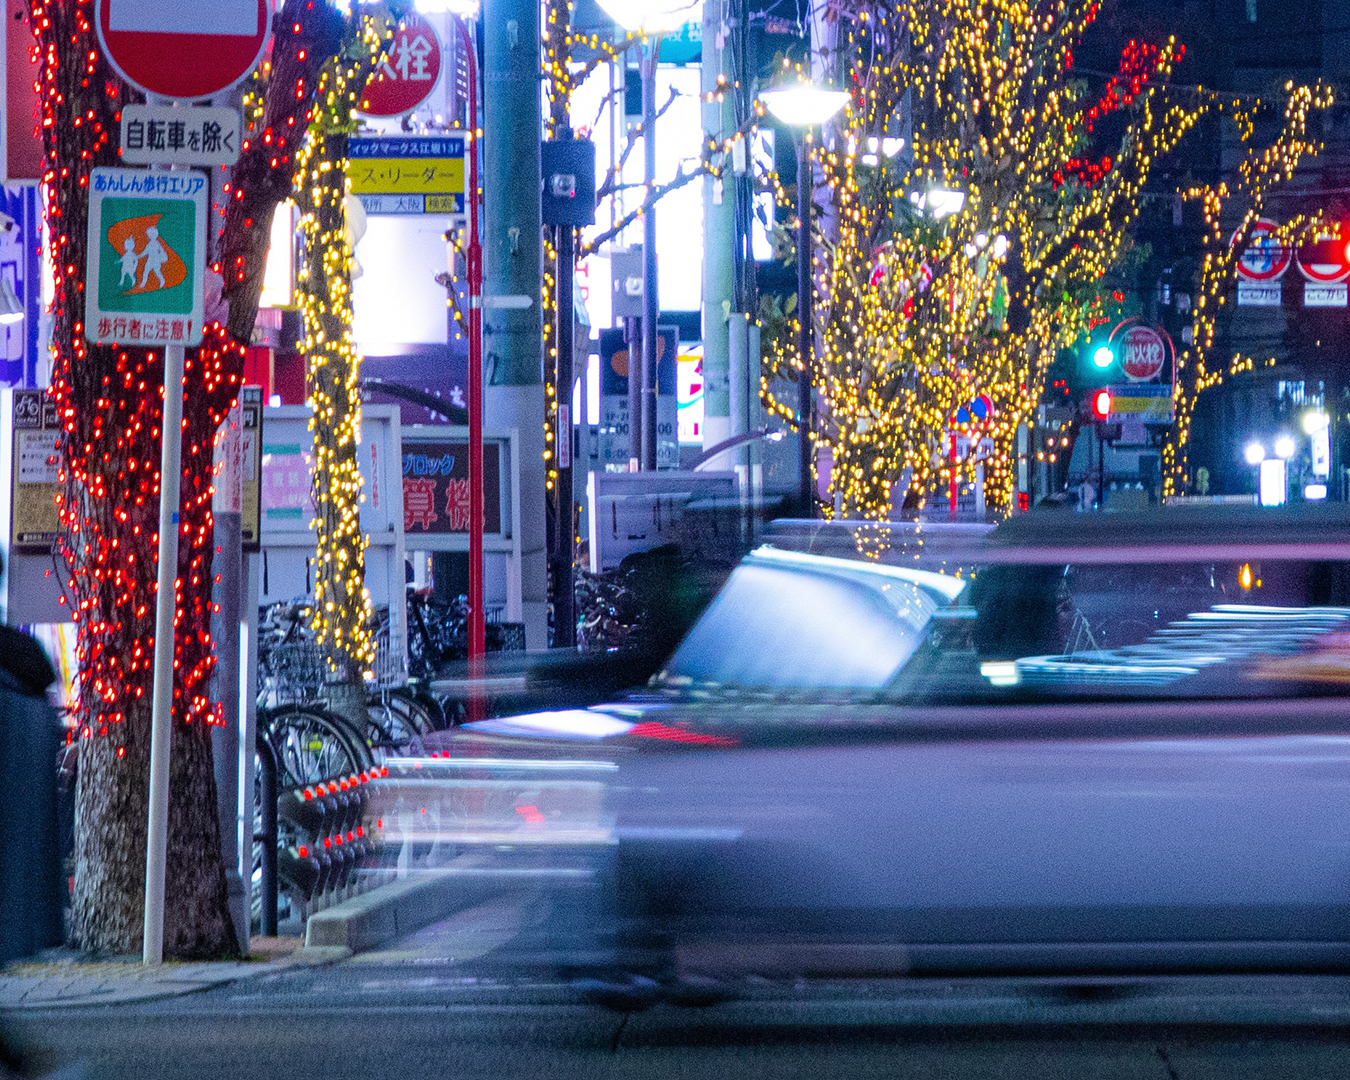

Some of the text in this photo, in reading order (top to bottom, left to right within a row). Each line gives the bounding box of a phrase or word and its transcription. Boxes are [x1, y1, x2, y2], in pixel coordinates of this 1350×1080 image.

[127, 119, 235, 153] 自転車を除く
[347, 142, 460, 155] ィックマークス江坂13F
[94, 175, 204, 195] あんしん歩行エリア
[98, 317, 193, 341] 歩行者に注意!
